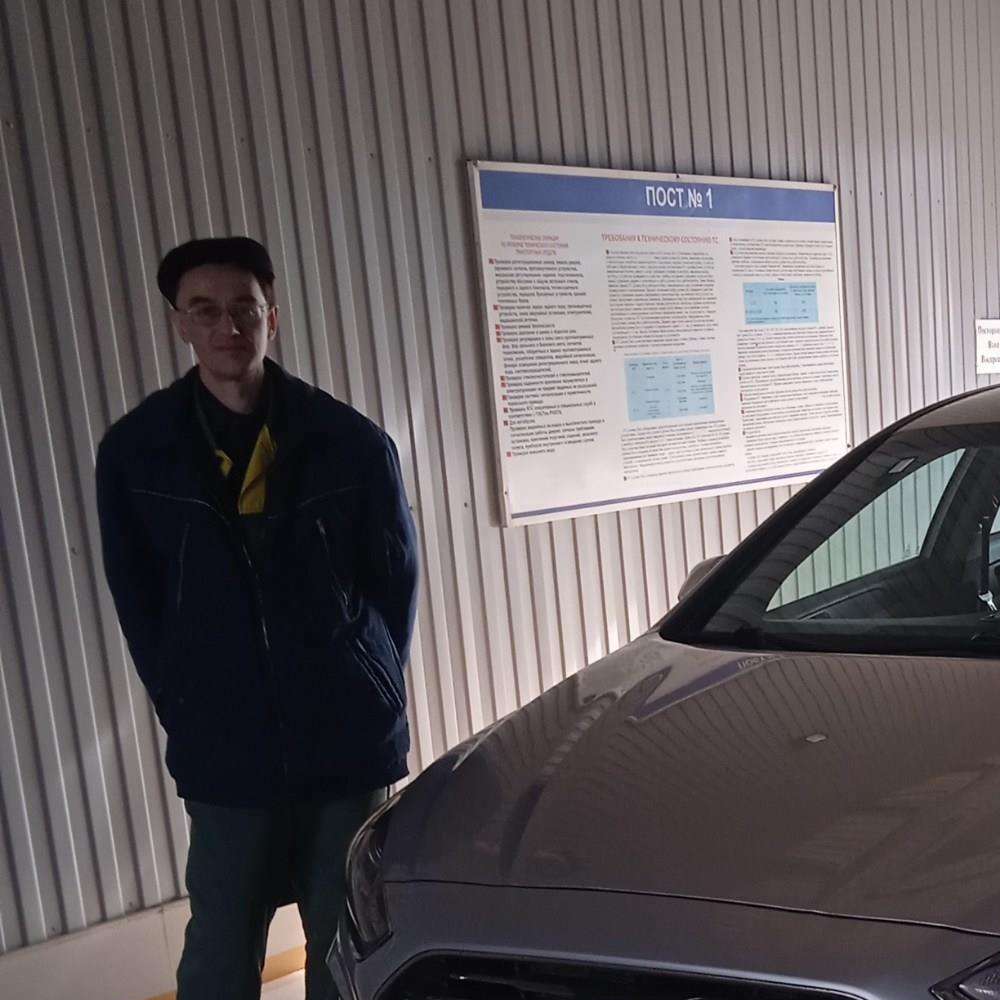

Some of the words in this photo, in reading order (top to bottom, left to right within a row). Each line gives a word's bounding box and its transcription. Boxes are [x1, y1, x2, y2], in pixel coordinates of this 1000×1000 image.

[646, 185, 685, 208] ПОСТ
[688, 187, 703, 209] №
[706, 187, 713, 209] 1
